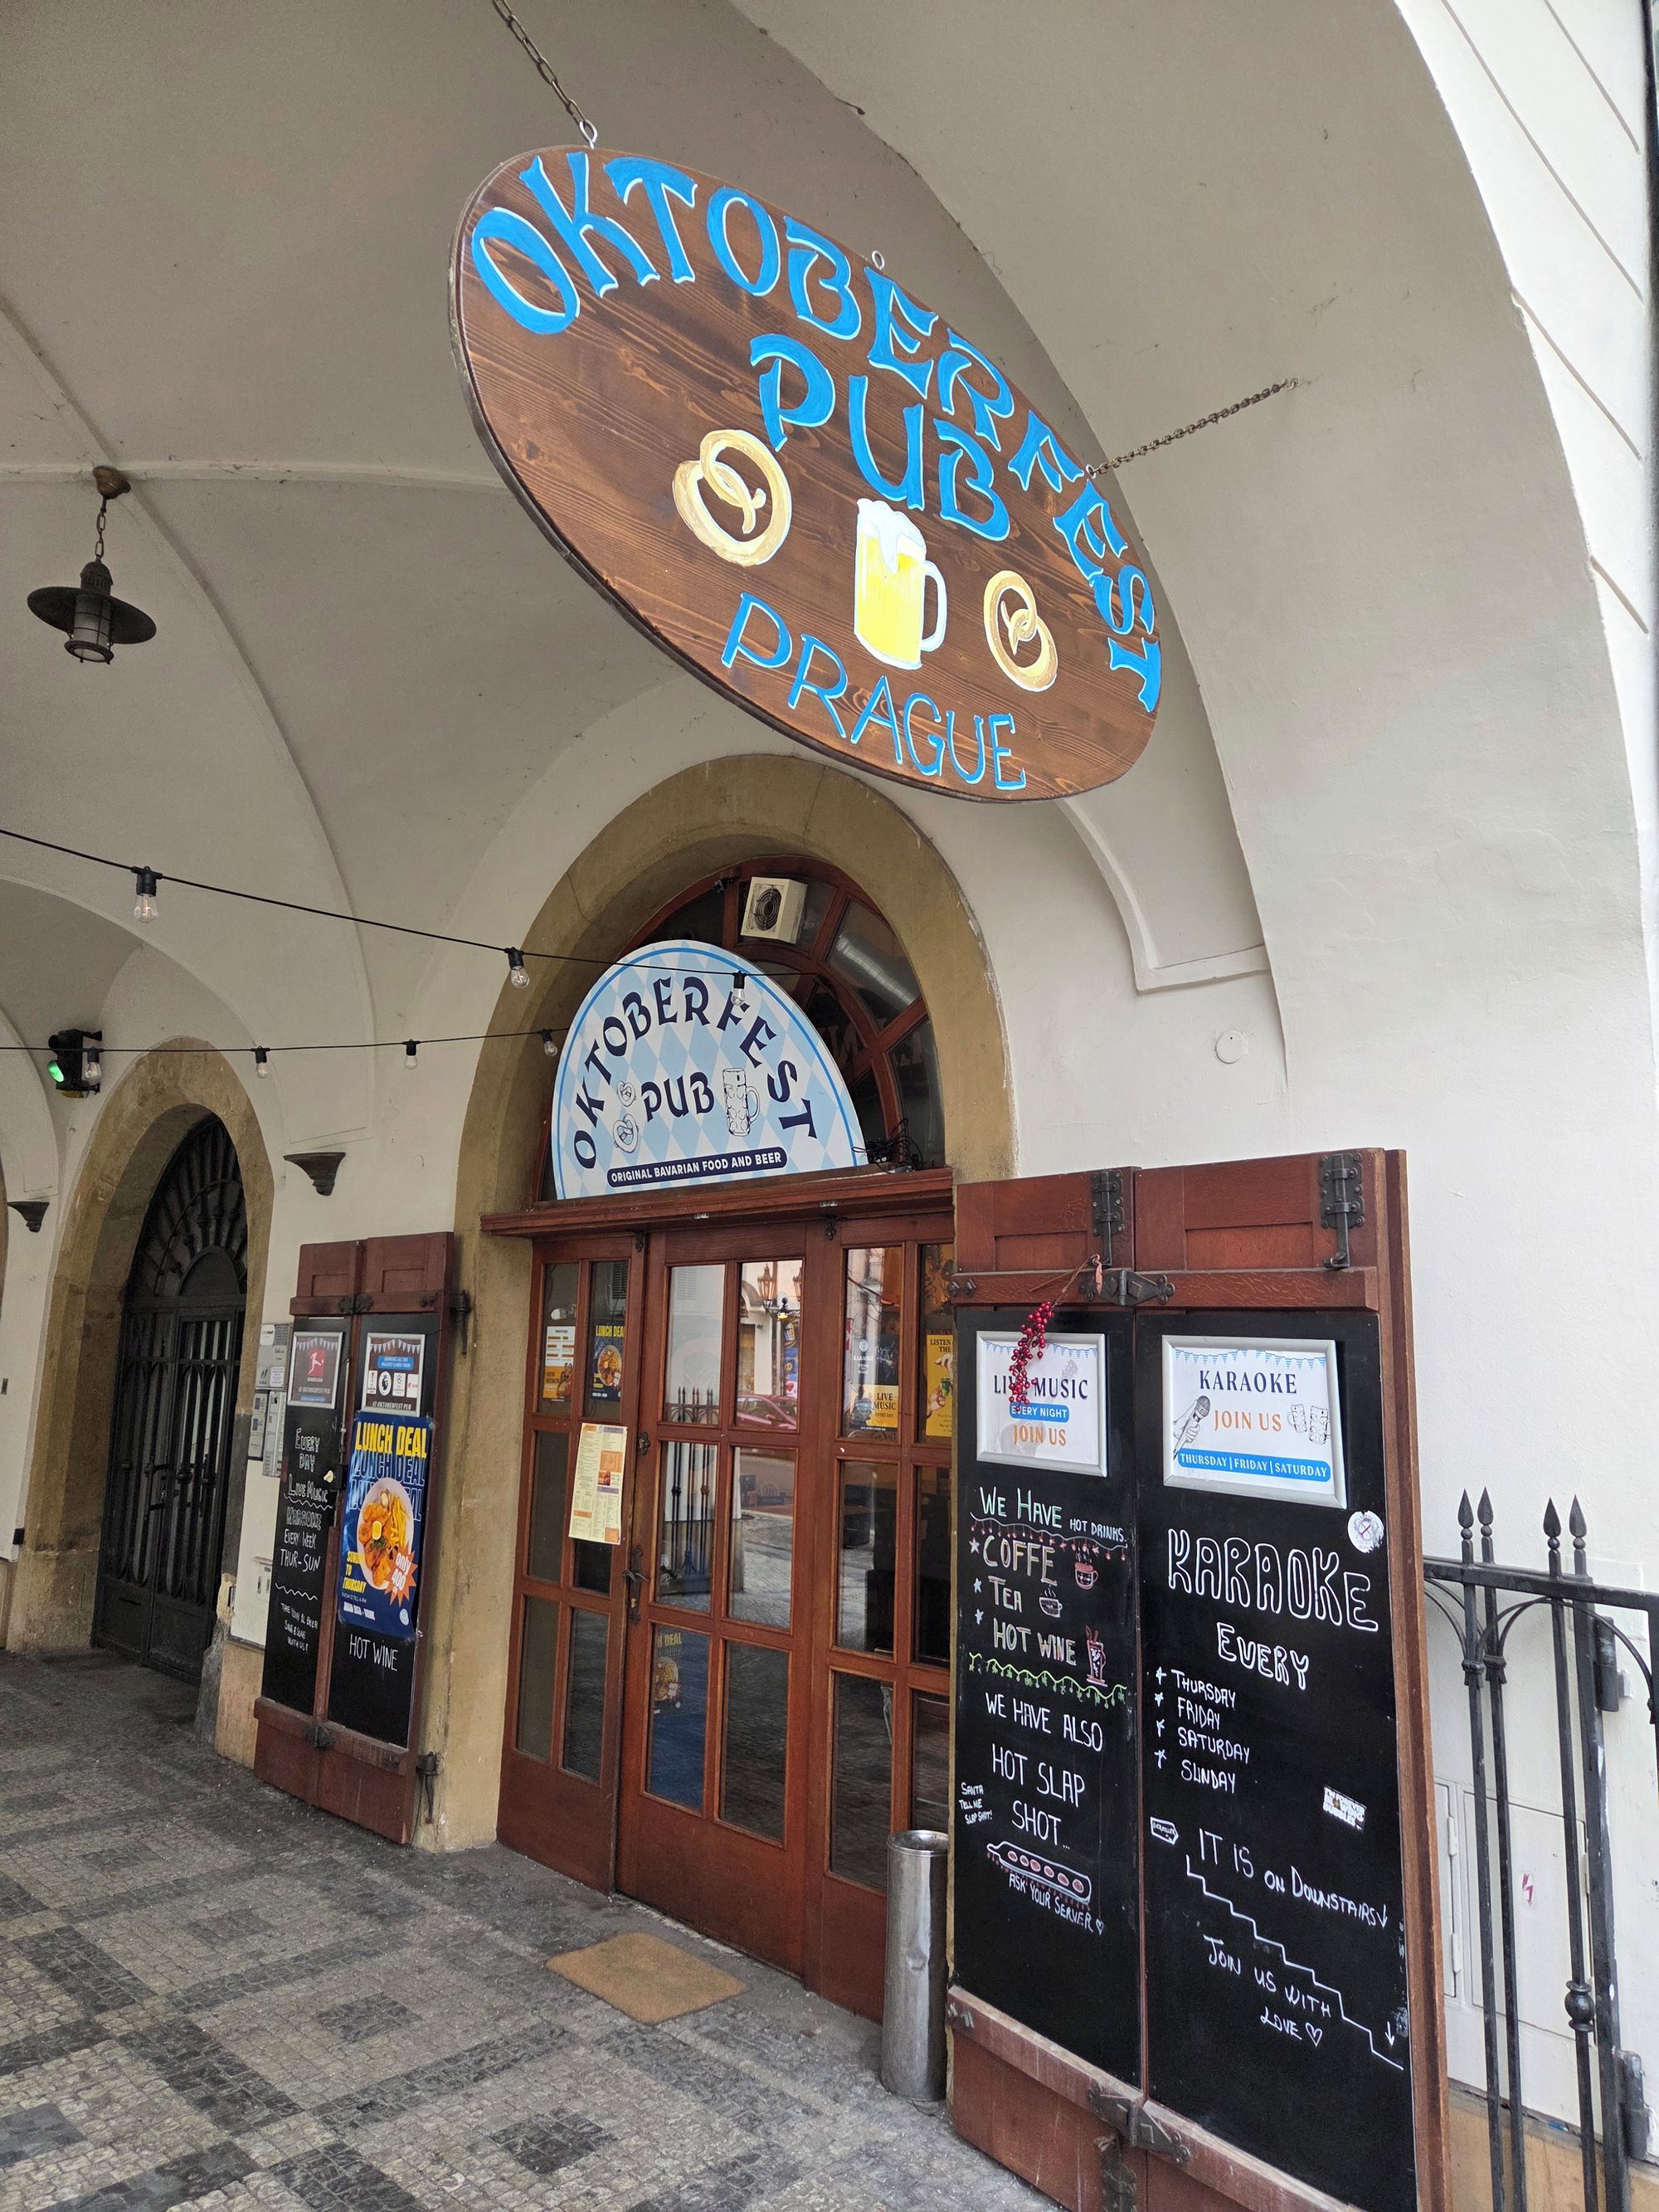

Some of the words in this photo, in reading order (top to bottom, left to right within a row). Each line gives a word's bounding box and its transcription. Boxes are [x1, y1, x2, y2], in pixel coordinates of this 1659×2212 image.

[471, 150, 1161, 713] OKTOBERFEST
[750, 333, 1011, 542] PUB
[721, 592, 1027, 791] PRAGUE
[573, 976, 817, 1168] OKTOBERFEST
[641, 1071, 714, 1122] PUB
[611, 1168, 652, 1182] ORIGINAL
[654, 1162, 700, 1177] BAVARIAN
[702, 1157, 728, 1172] FOOD
[731, 1155, 752, 1169] AND
[755, 1152, 781, 1166] BEER
[877, 1393, 893, 1401] LIVE
[994, 1375, 1028, 1396] LI
[1034, 1377, 1088, 1400] MUSIC
[1199, 1370, 1297, 1395] KARAOKE
[873, 1401, 896, 1410] MUSIC
[1039, 1407, 1068, 1419] NIGHT
[1214, 1410, 1252, 1431] JOIN
[1258, 1412, 1282, 1432] US
[294, 1427, 320, 1453] EVERY
[354, 1421, 394, 1454] LUNCH
[396, 1425, 427, 1459] DEAL
[1013, 1425, 1044, 1445] JOIN
[1048, 1428, 1067, 1447] US
[299, 1453, 315, 1473] DAY
[1180, 1453, 1228, 1467] THURSDAY
[1234, 1459, 1267, 1472] FRIDAY
[1274, 1462, 1328, 1478] SATURDAY
[307, 1480, 328, 1503] MUSIC
[980, 1486, 1007, 1518] WE
[1017, 1487, 1063, 1528] HAVE
[286, 1506, 323, 1531] KARAOKE
[1069, 1518, 1088, 1532] HOT
[284, 1528, 299, 1546] EVERY
[303, 1531, 317, 1550] WEEK
[983, 1534, 1058, 1586] COFFE
[988, 1575, 1023, 1614] TEA
[1167, 1528, 1379, 1632] KARAOKE
[306, 1615, 319, 1630] BEER
[349, 1633, 371, 1659] HOT
[372, 1641, 399, 1672] WINE
[994, 1617, 1032, 1653] HOT
[1037, 1632, 1077, 1666] WINE
[1216, 1621, 1309, 1691] EVERY
[1170, 1669, 1236, 1708] THURSDAY
[985, 1692, 1007, 1718] WE
[1013, 1698, 1052, 1734] HAVE
[1063, 1714, 1103, 1752] ALSO
[1177, 1696, 1220, 1731] FRIDAY
[1177, 1726, 1250, 1765] SATURDAY
[961, 1781, 984, 1795] SANTA
[992, 1742, 1029, 1786] HOT
[1036, 1761, 1085, 1808] SLAP
[1180, 1759, 1236, 1794] SUNDAY
[958, 1799, 973, 1810] TELL
[1199, 1827, 1224, 1865] IT
[1233, 1843, 1254, 1878] IS
[1263, 1869, 1286, 1893] ON
[1291, 1865, 1377, 1926] DOWNSTAIRS
[1009, 1873, 1026, 1894] ASK
[1029, 1883, 1051, 1909] YOUR
[1054, 1895, 1094, 1932] SERVER
[1203, 1933, 1241, 1976] JOIN
[1253, 1966, 1277, 1993] US
[1285, 1984, 1331, 2018] WITH
[1260, 2006, 1303, 2040] LOVE
